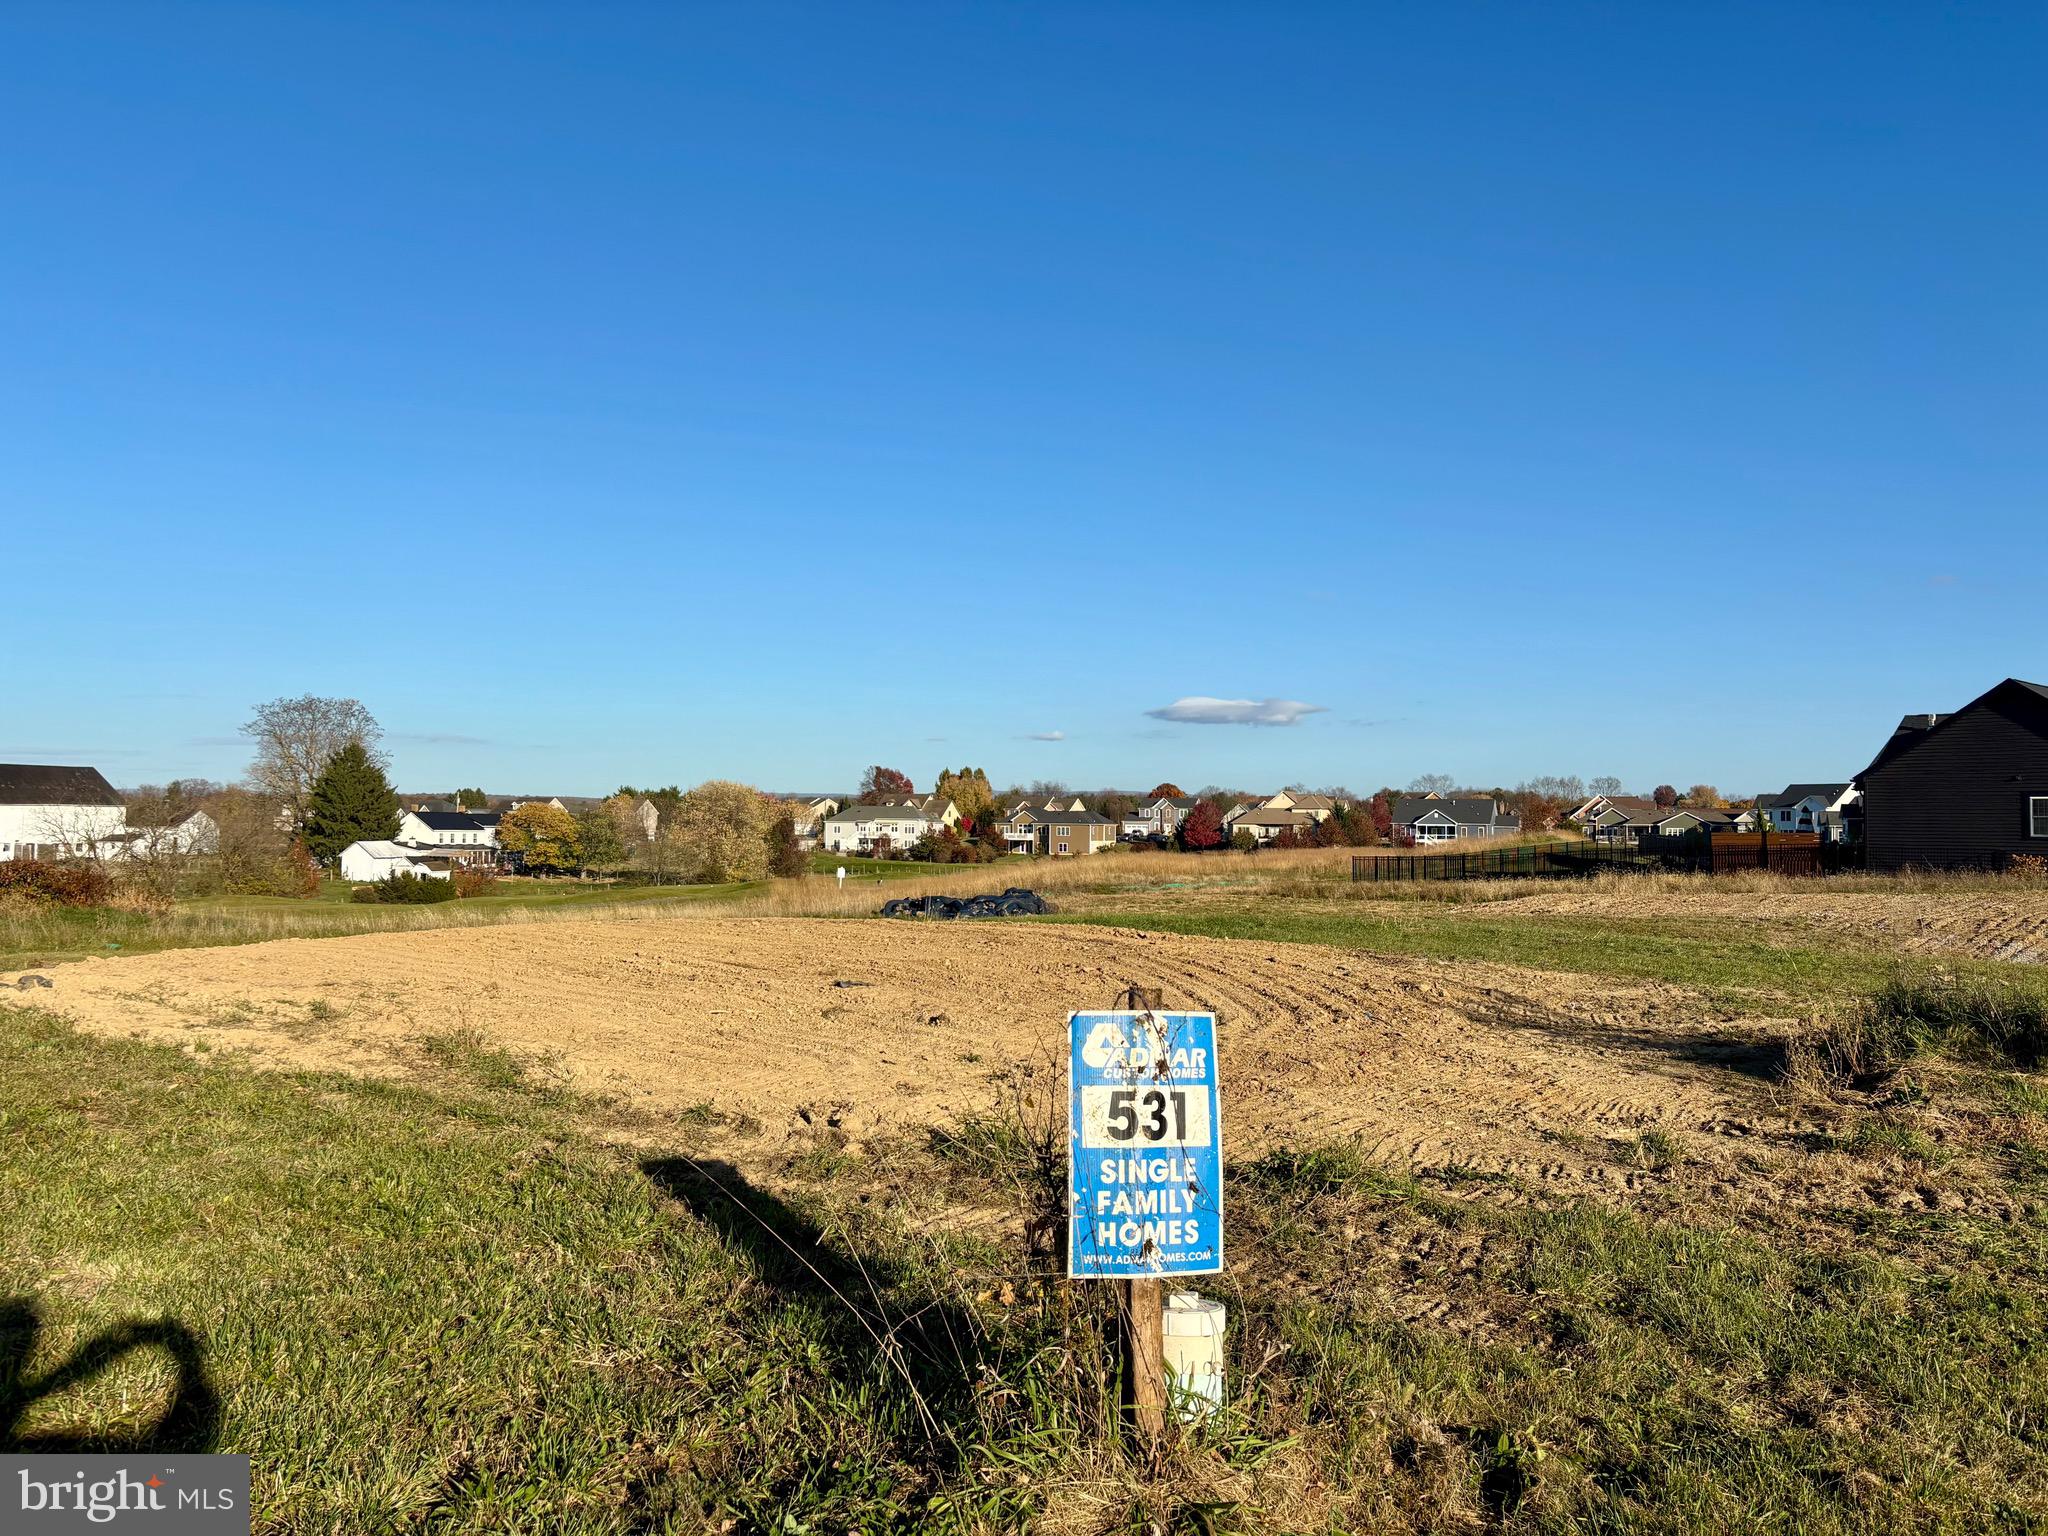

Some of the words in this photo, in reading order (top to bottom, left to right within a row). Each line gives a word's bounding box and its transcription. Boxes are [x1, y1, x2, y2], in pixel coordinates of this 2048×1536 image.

[1103, 1067, 1160, 1079] CUSO
[1165, 1067, 1206, 1078] OMES
[1106, 1090, 1187, 1142] 531
[1100, 1158, 1197, 1184] SINGLE
[1097, 1189, 1198, 1215] FAMILY
[1098, 1219, 1200, 1247] HOMES
[1083, 1251, 1211, 1265] WWW.ADMAROMES.COM
